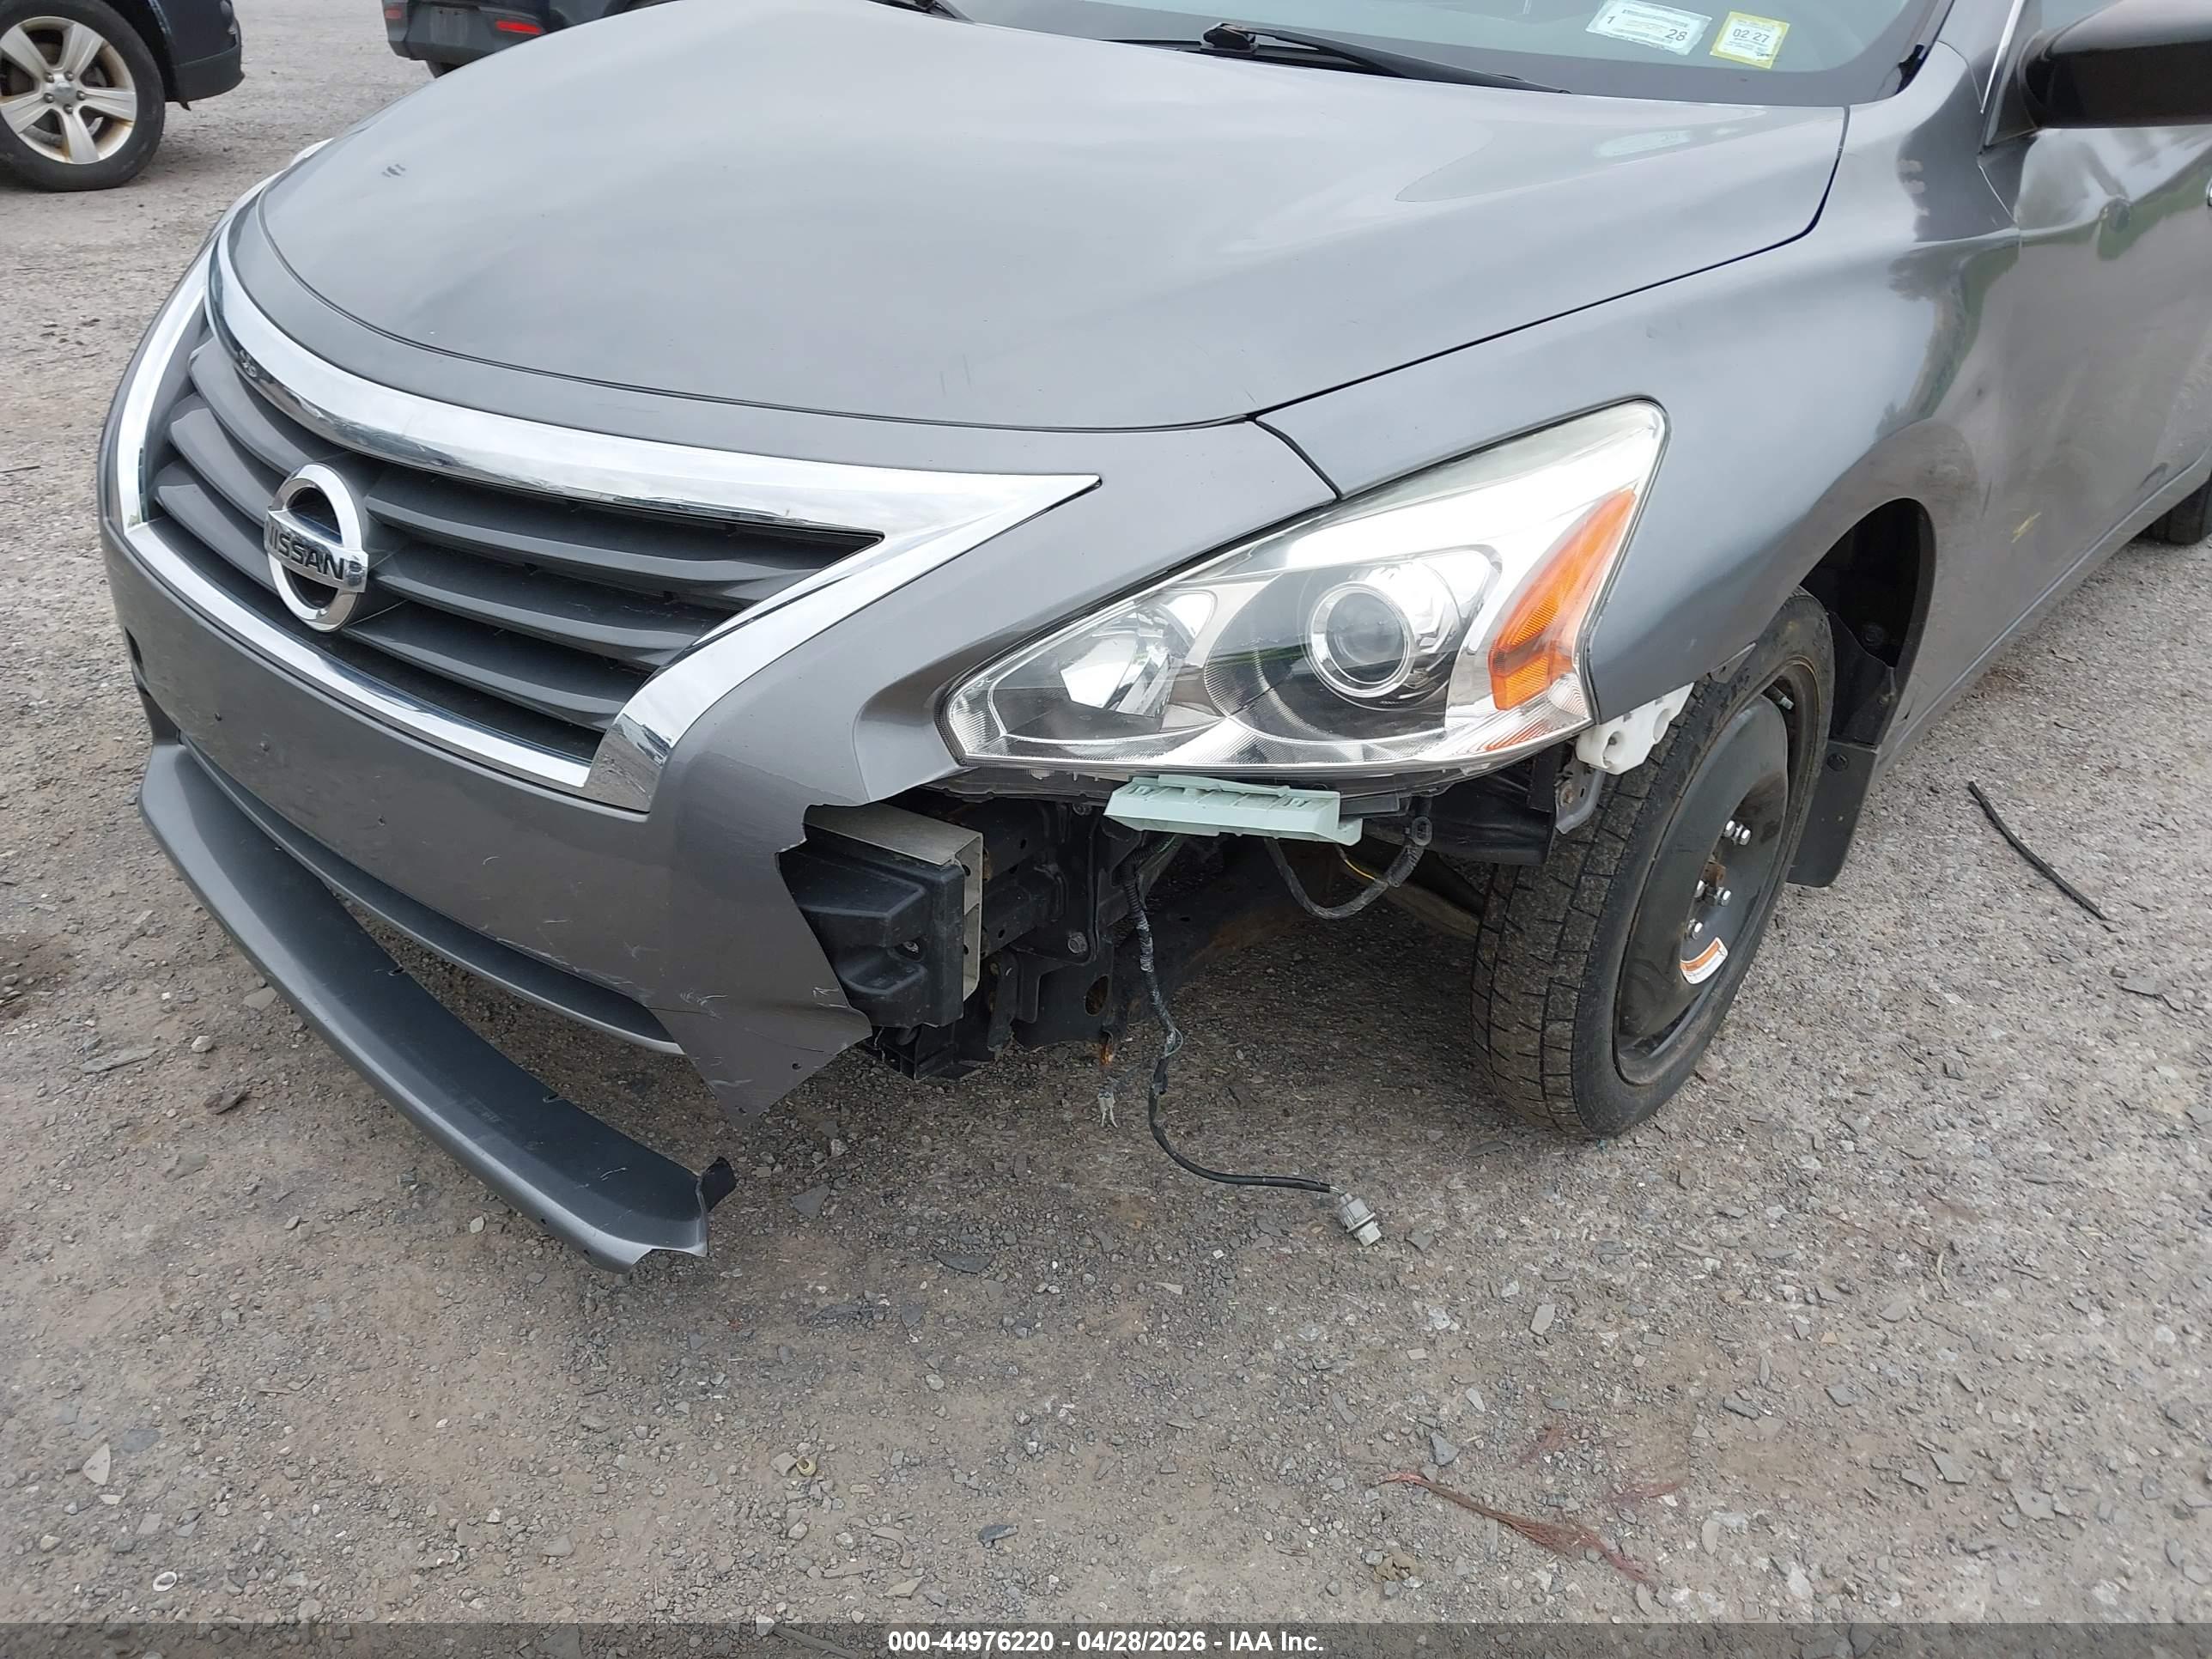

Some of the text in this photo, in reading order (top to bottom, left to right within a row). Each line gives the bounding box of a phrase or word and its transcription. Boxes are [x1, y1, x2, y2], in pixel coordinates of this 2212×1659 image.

[1607, 15, 1615, 24] 1
[1665, 28, 1687, 41] 28
[1733, 28, 1770, 43] 02 27
